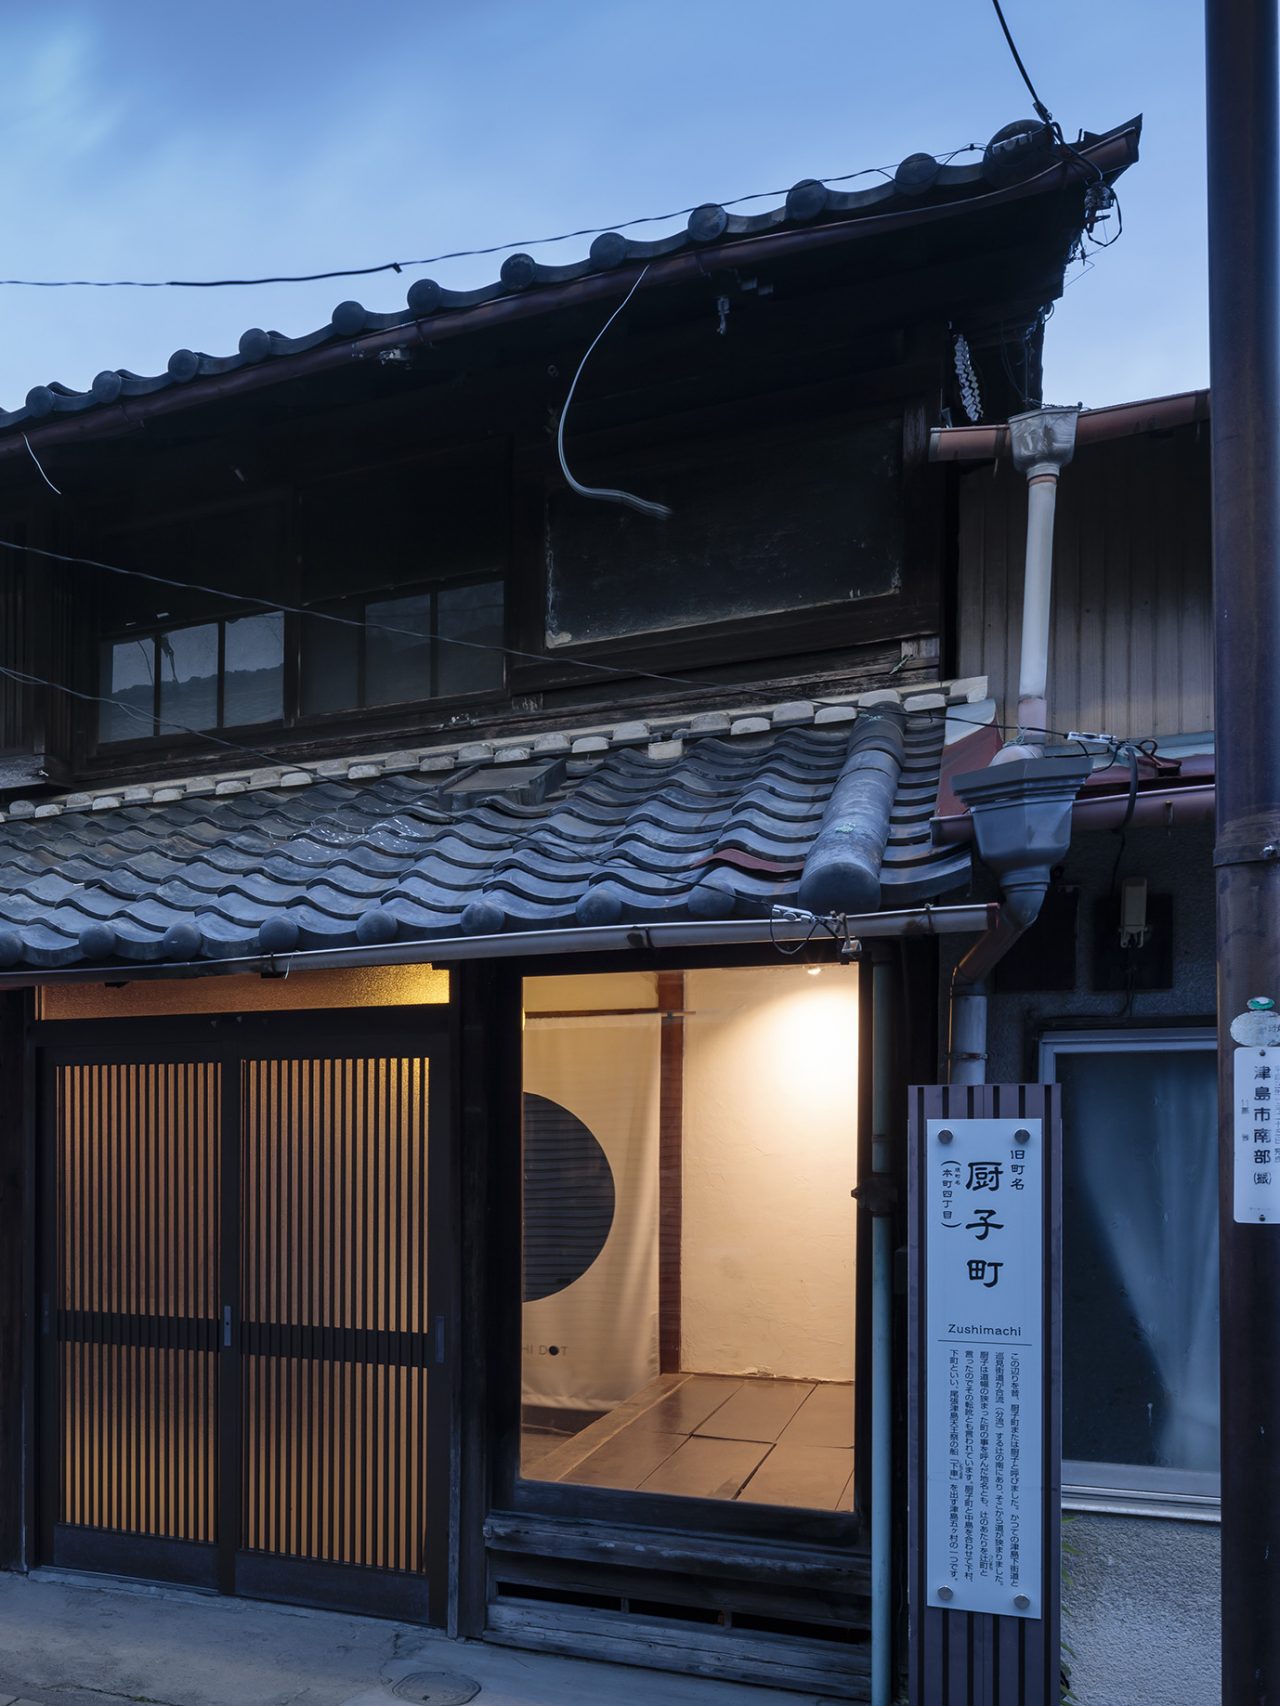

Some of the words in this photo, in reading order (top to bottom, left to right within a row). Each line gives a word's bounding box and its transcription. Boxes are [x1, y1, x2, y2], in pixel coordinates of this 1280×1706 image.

[1010, 1150, 1025, 1190] 旧町名
[965, 1161, 1004, 1288] 厨子町
[947, 1323, 1022, 1337] Zushimachi
